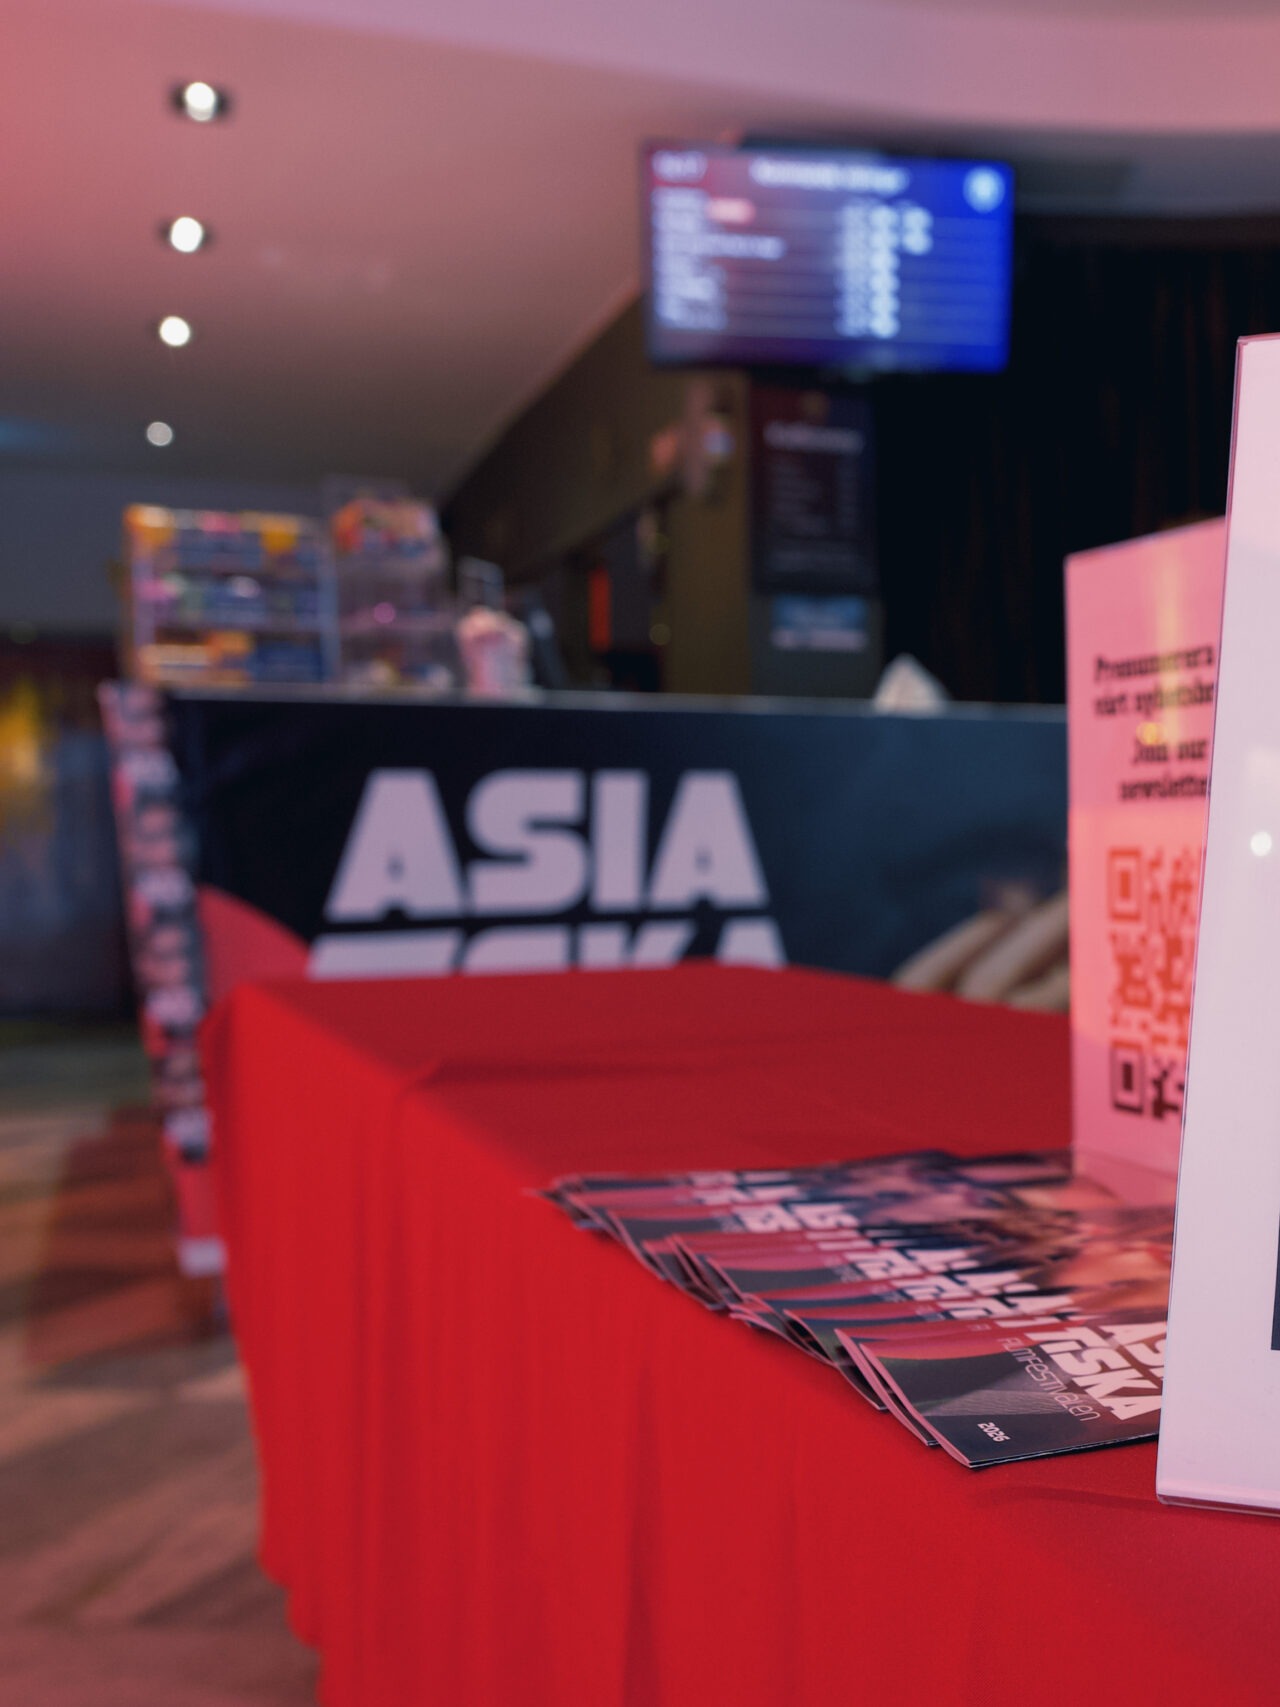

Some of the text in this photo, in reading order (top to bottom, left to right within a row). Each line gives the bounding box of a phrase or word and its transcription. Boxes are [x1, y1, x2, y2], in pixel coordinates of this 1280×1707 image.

[323, 766, 770, 922] ASIA
[1023, 1325, 1164, 1421] TISKA
[977, 1421, 1011, 1443] 2026
